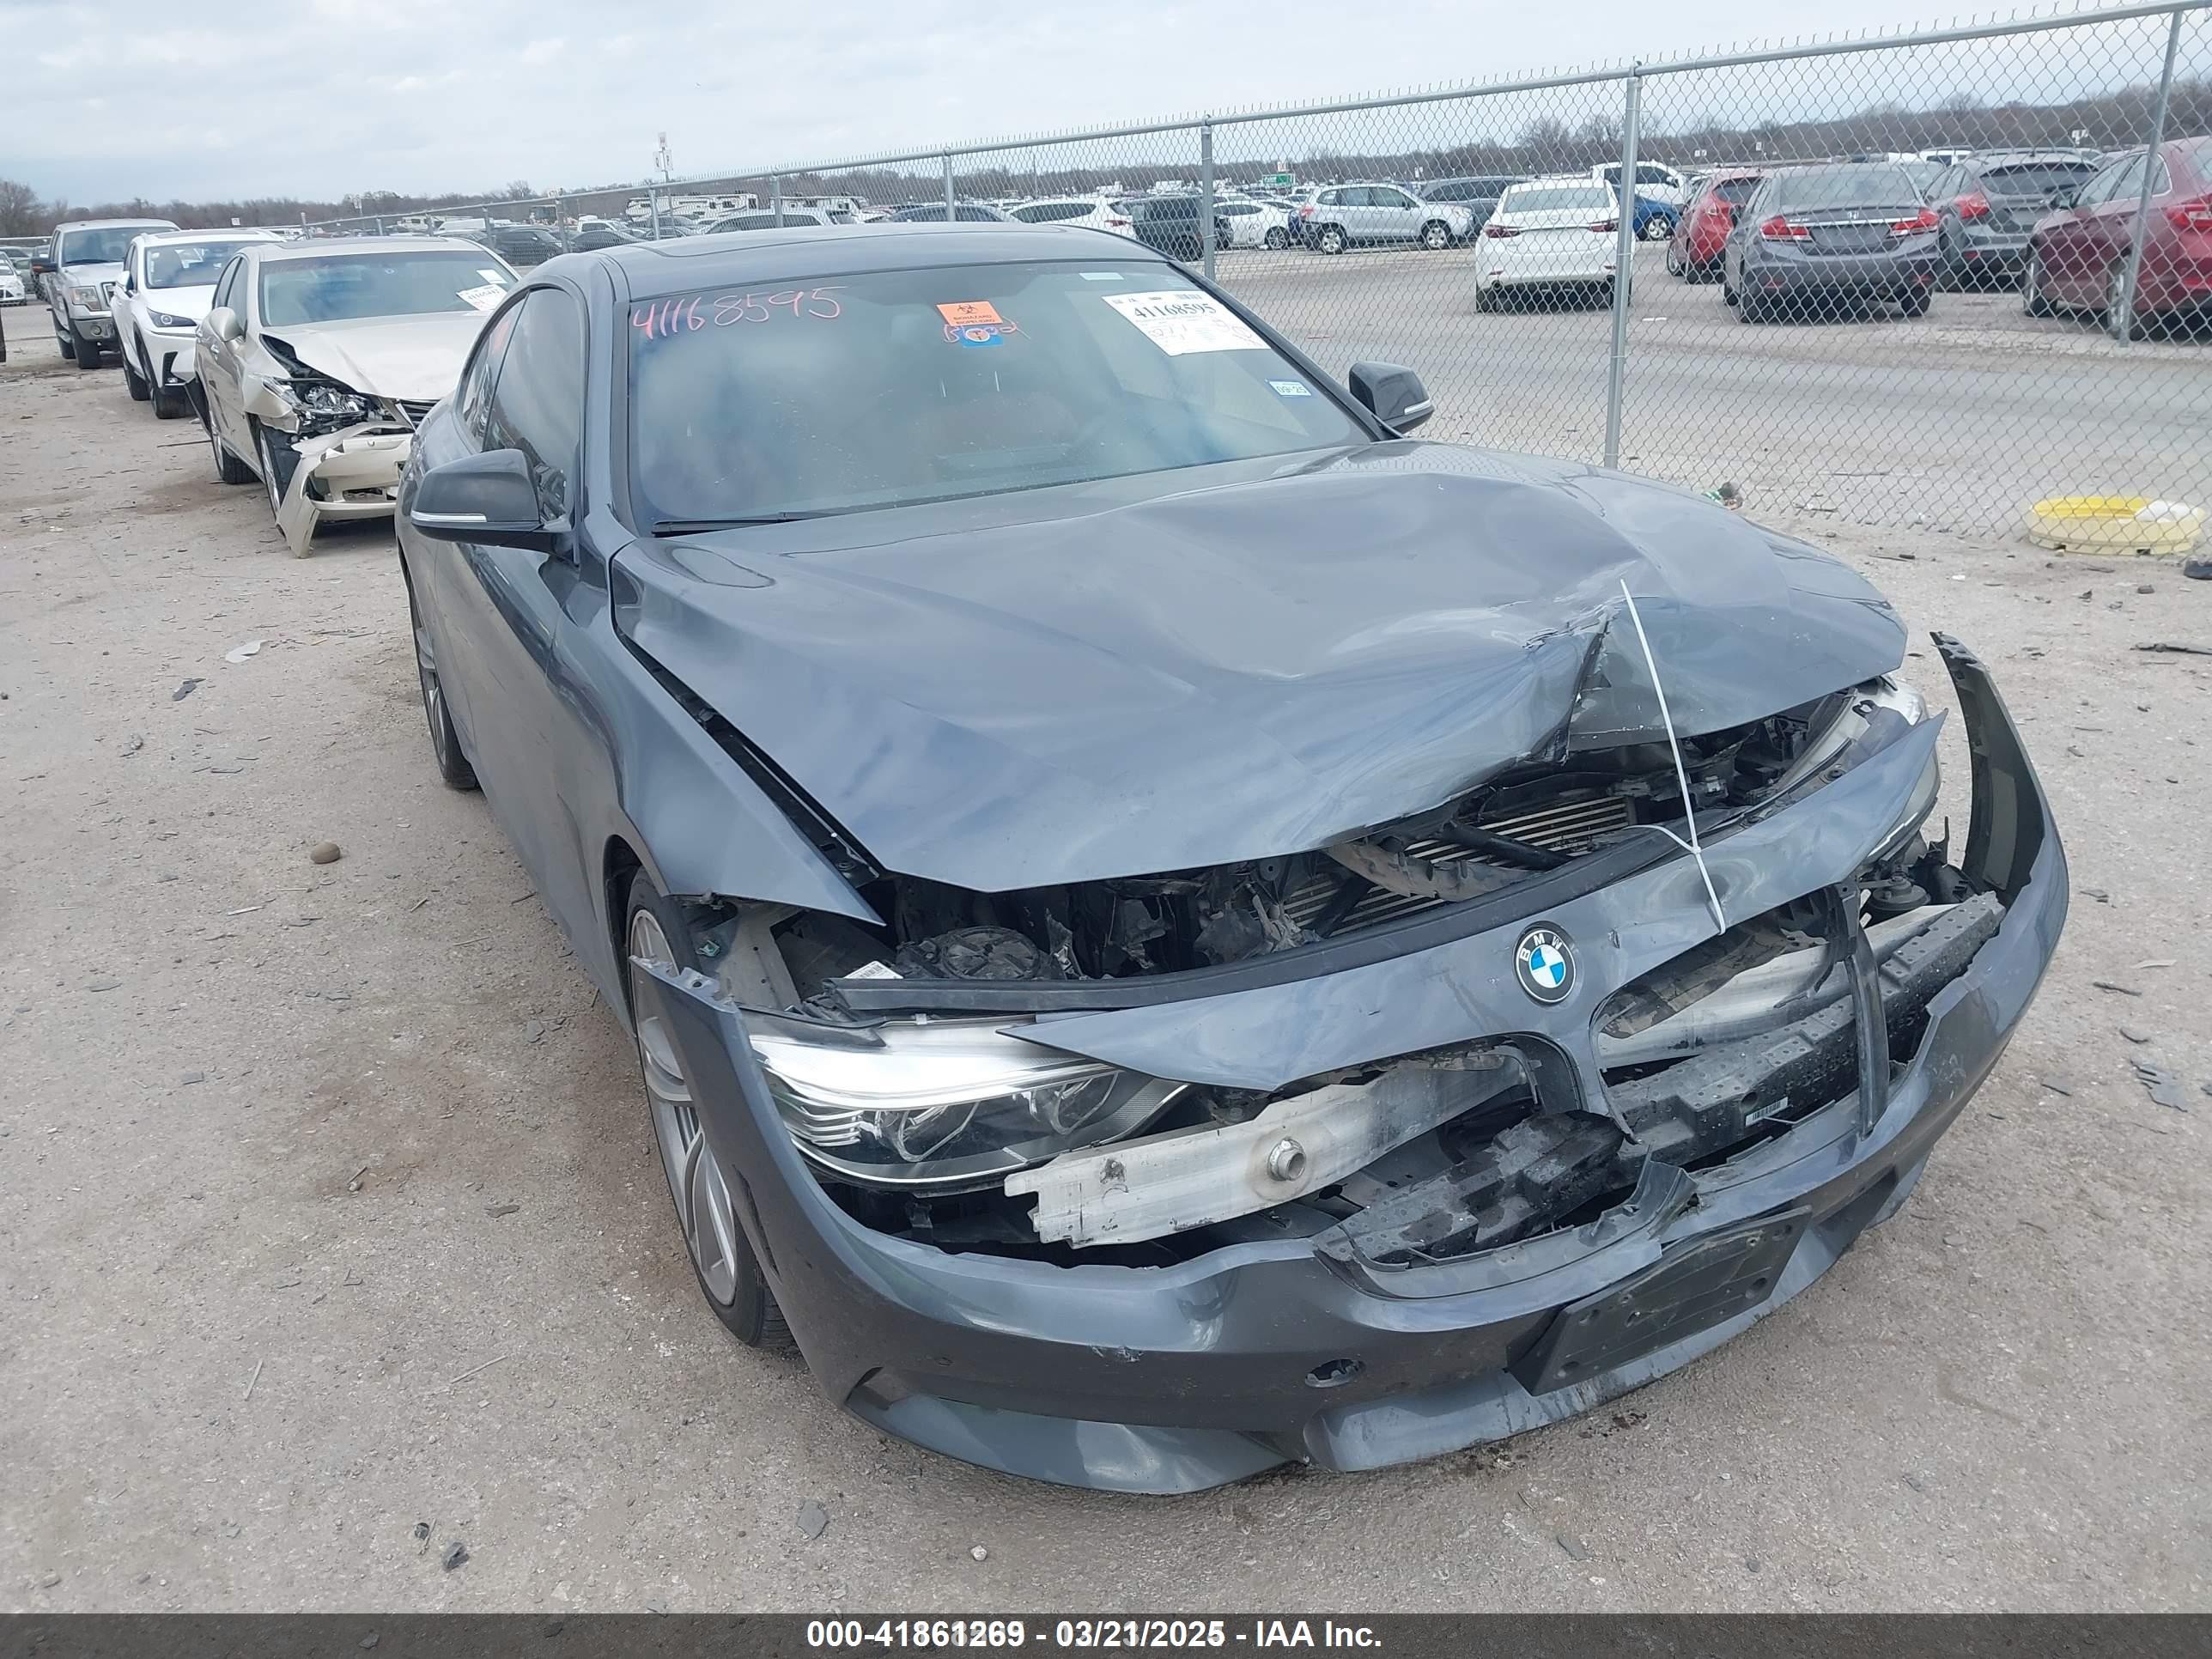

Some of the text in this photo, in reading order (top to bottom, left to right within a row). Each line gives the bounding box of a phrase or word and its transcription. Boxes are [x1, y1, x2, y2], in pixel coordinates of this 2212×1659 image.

[632, 285, 848, 341] 41168595
[1134, 303, 1217, 318] 41168595
[1519, 933, 1563, 962] BMW
